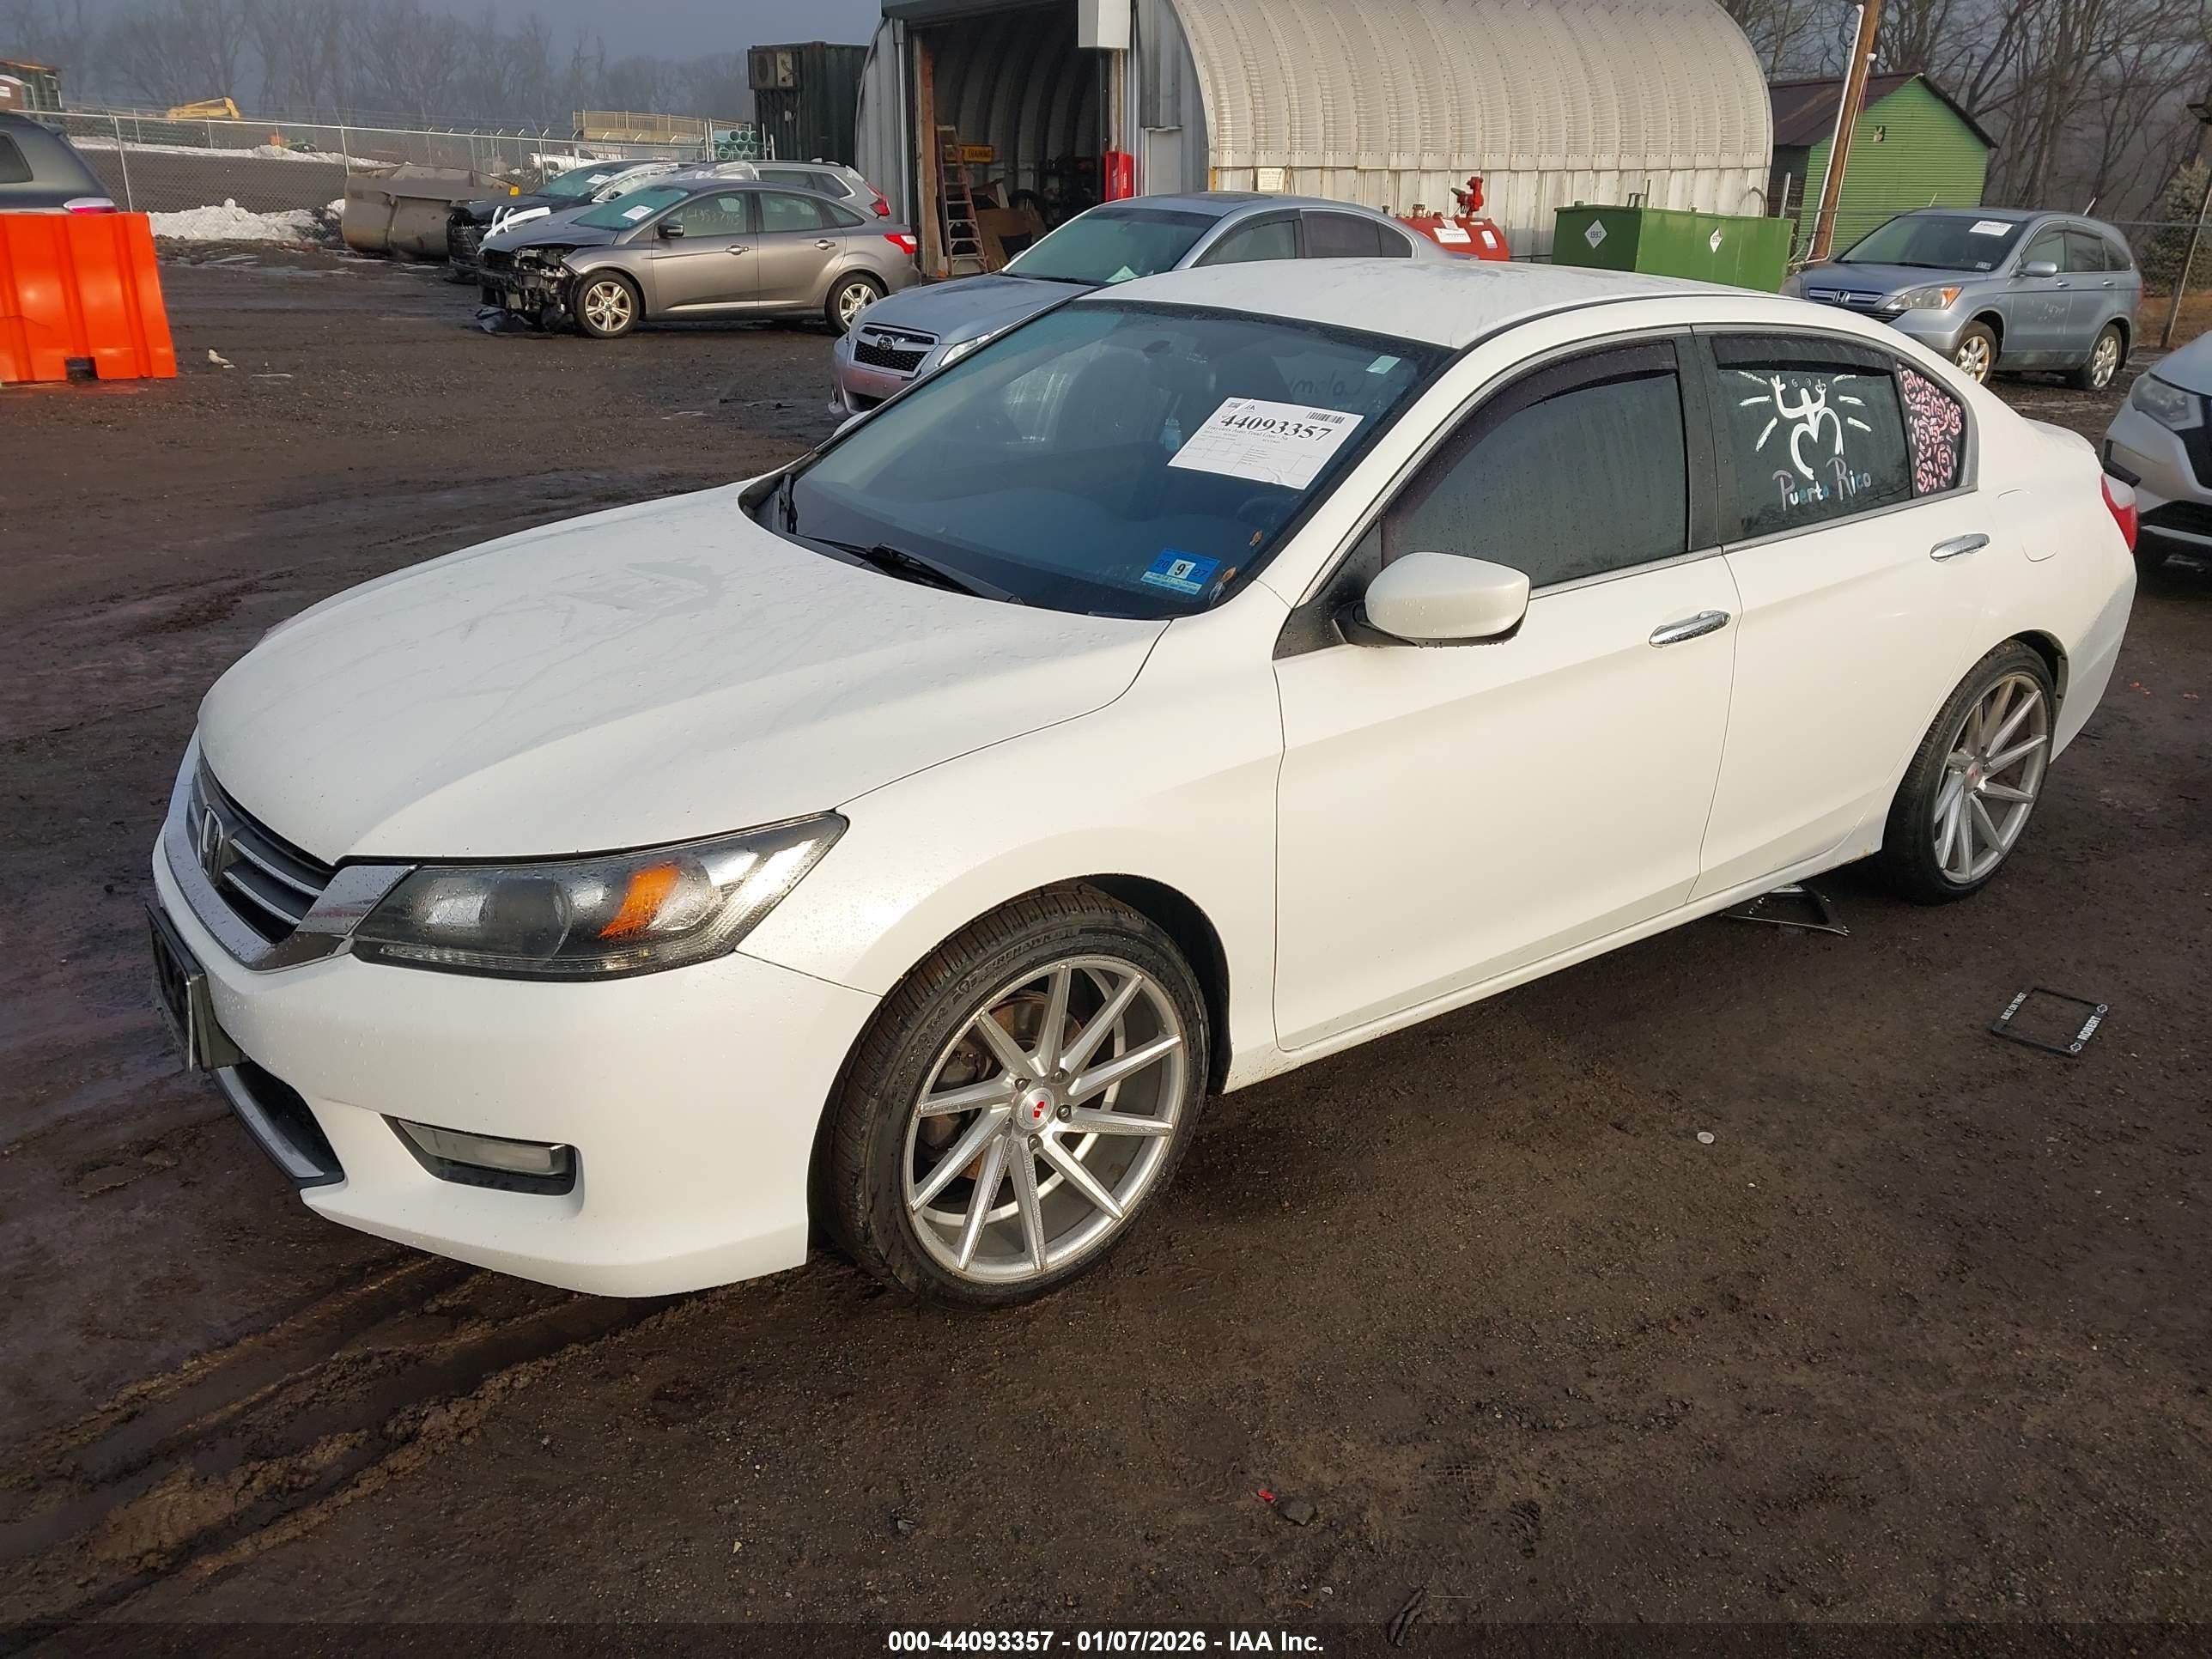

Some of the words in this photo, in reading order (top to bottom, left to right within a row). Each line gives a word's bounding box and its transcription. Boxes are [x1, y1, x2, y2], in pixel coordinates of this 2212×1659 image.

[1220, 414, 1334, 441] 44093357
[1771, 469, 1830, 512] Puerto
[1826, 456, 1872, 501] Rico
[1174, 563, 1186, 575] 9
[2077, 1015, 2102, 1041] ROBERT
